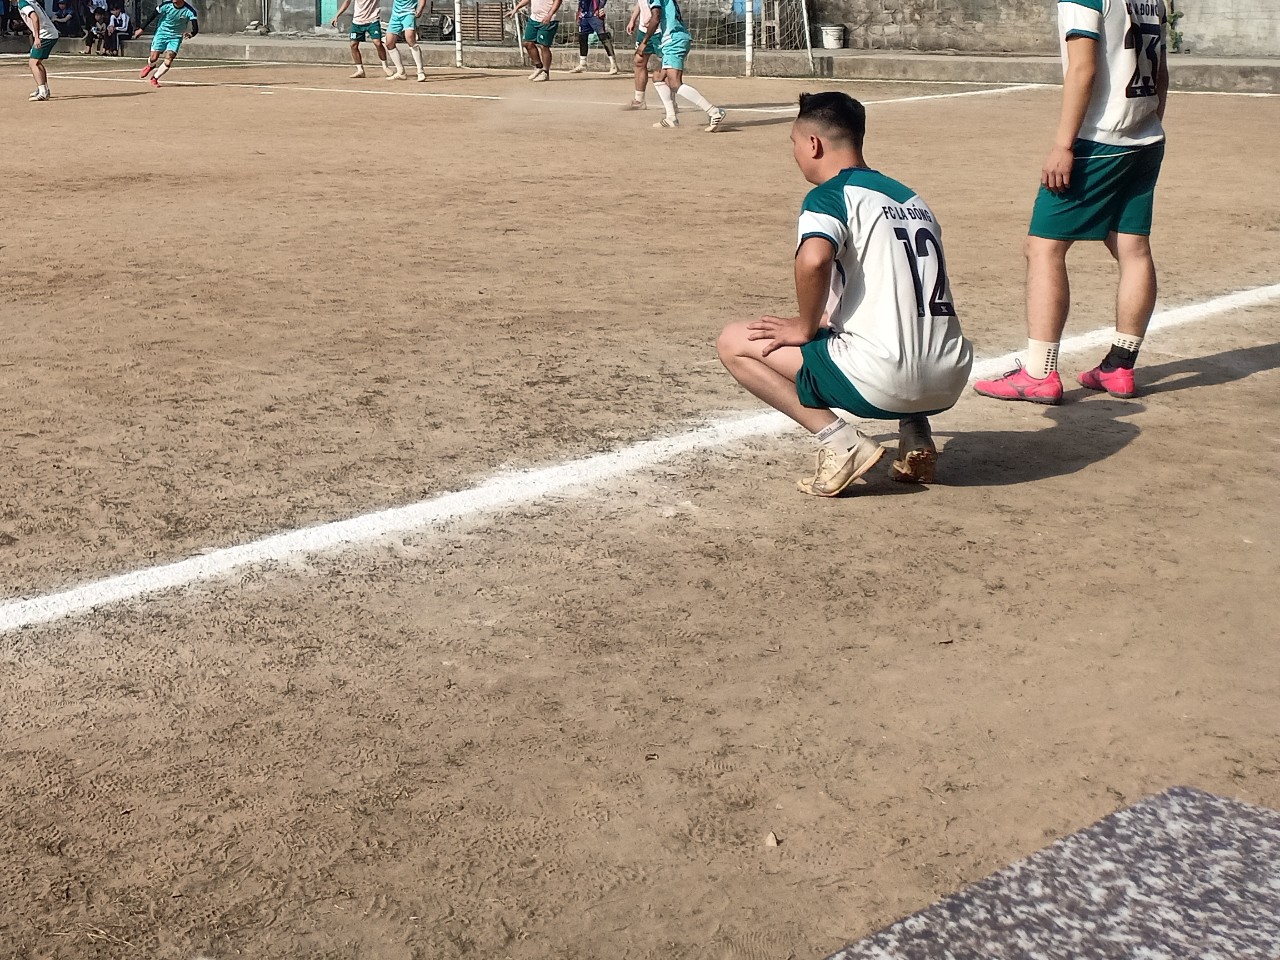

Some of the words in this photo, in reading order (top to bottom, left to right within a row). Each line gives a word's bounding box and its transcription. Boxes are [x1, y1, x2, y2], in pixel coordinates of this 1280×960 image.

[882, 205, 897, 220] FC
[894, 206, 909, 221] LA
[893, 227, 956, 318] 12
